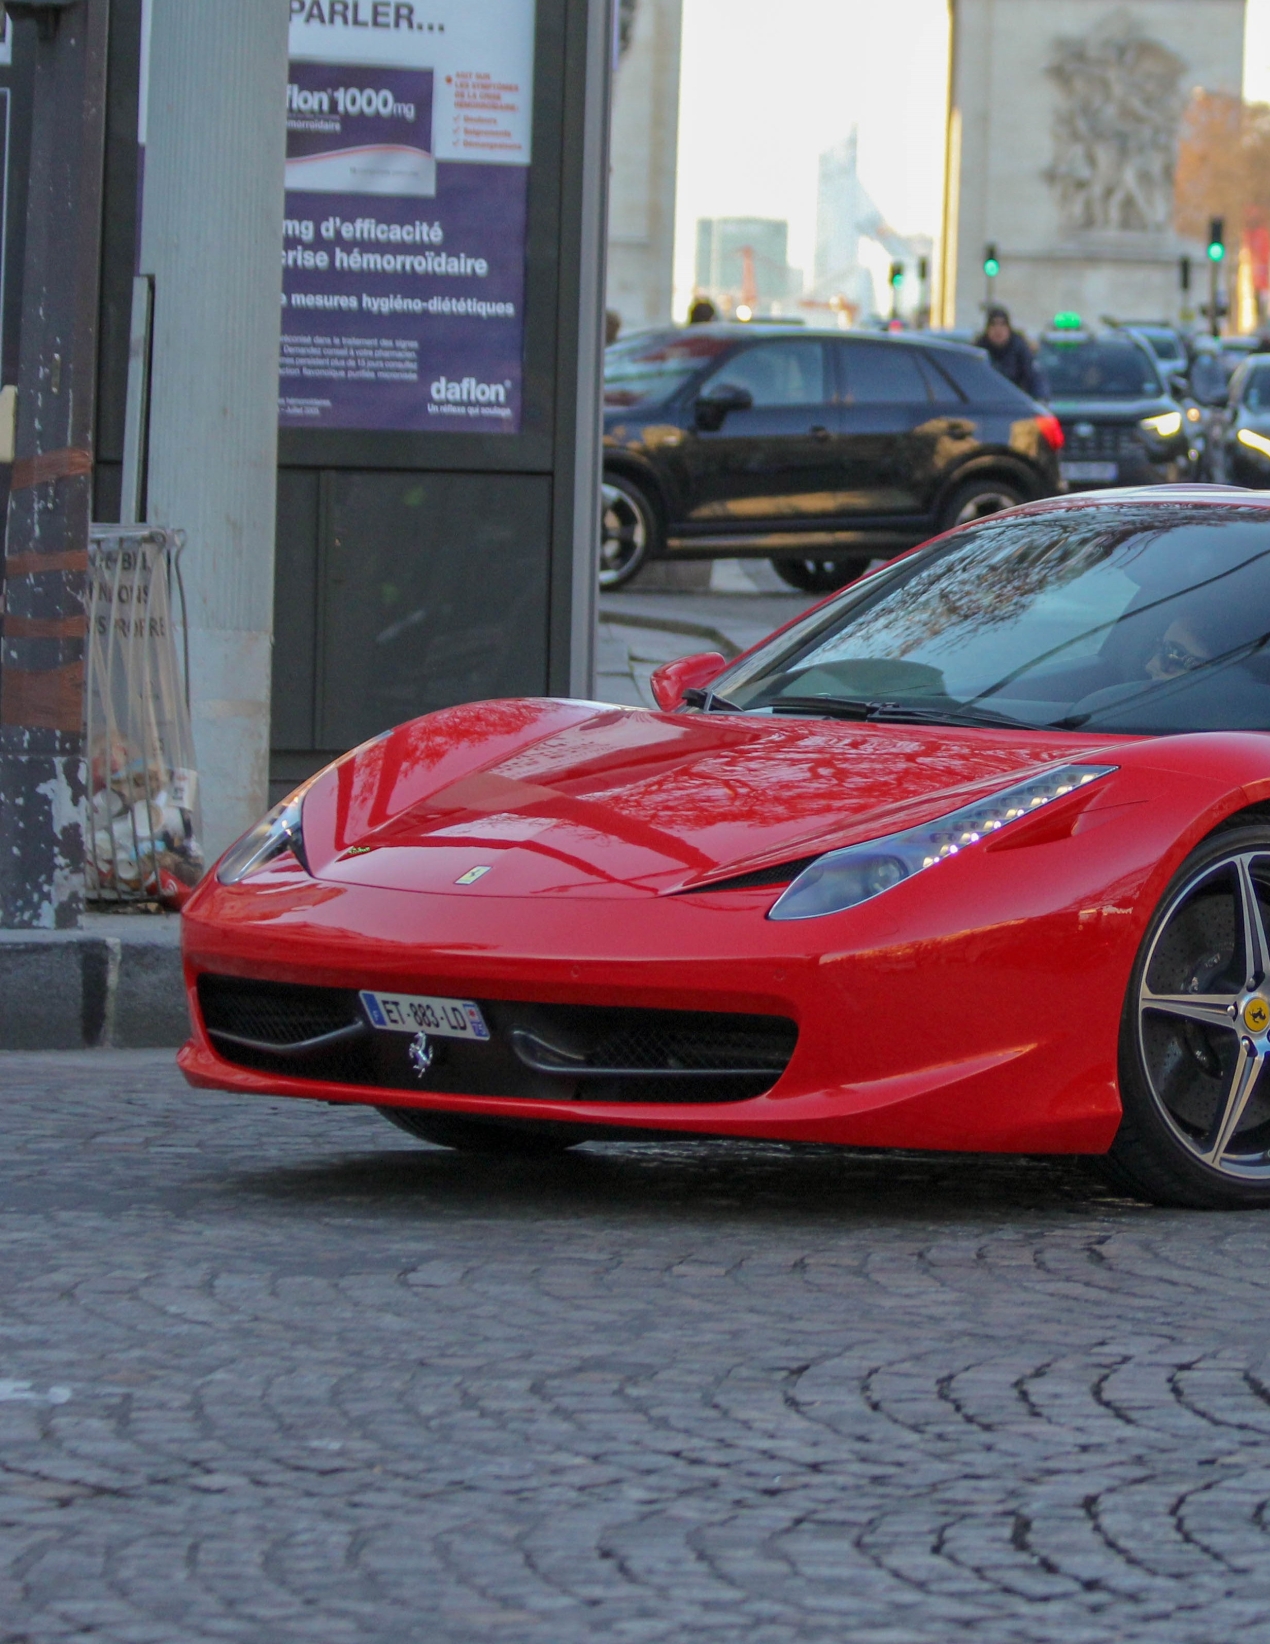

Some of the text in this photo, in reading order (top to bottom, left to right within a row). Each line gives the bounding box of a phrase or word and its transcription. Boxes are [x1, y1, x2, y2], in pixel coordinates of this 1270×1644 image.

[320, 216, 443, 244] d'efficacité
[335, 247, 489, 277] hémorroïdaire
[291, 293, 359, 312] mesures
[362, 293, 515, 319] hygiéno-diététiques
